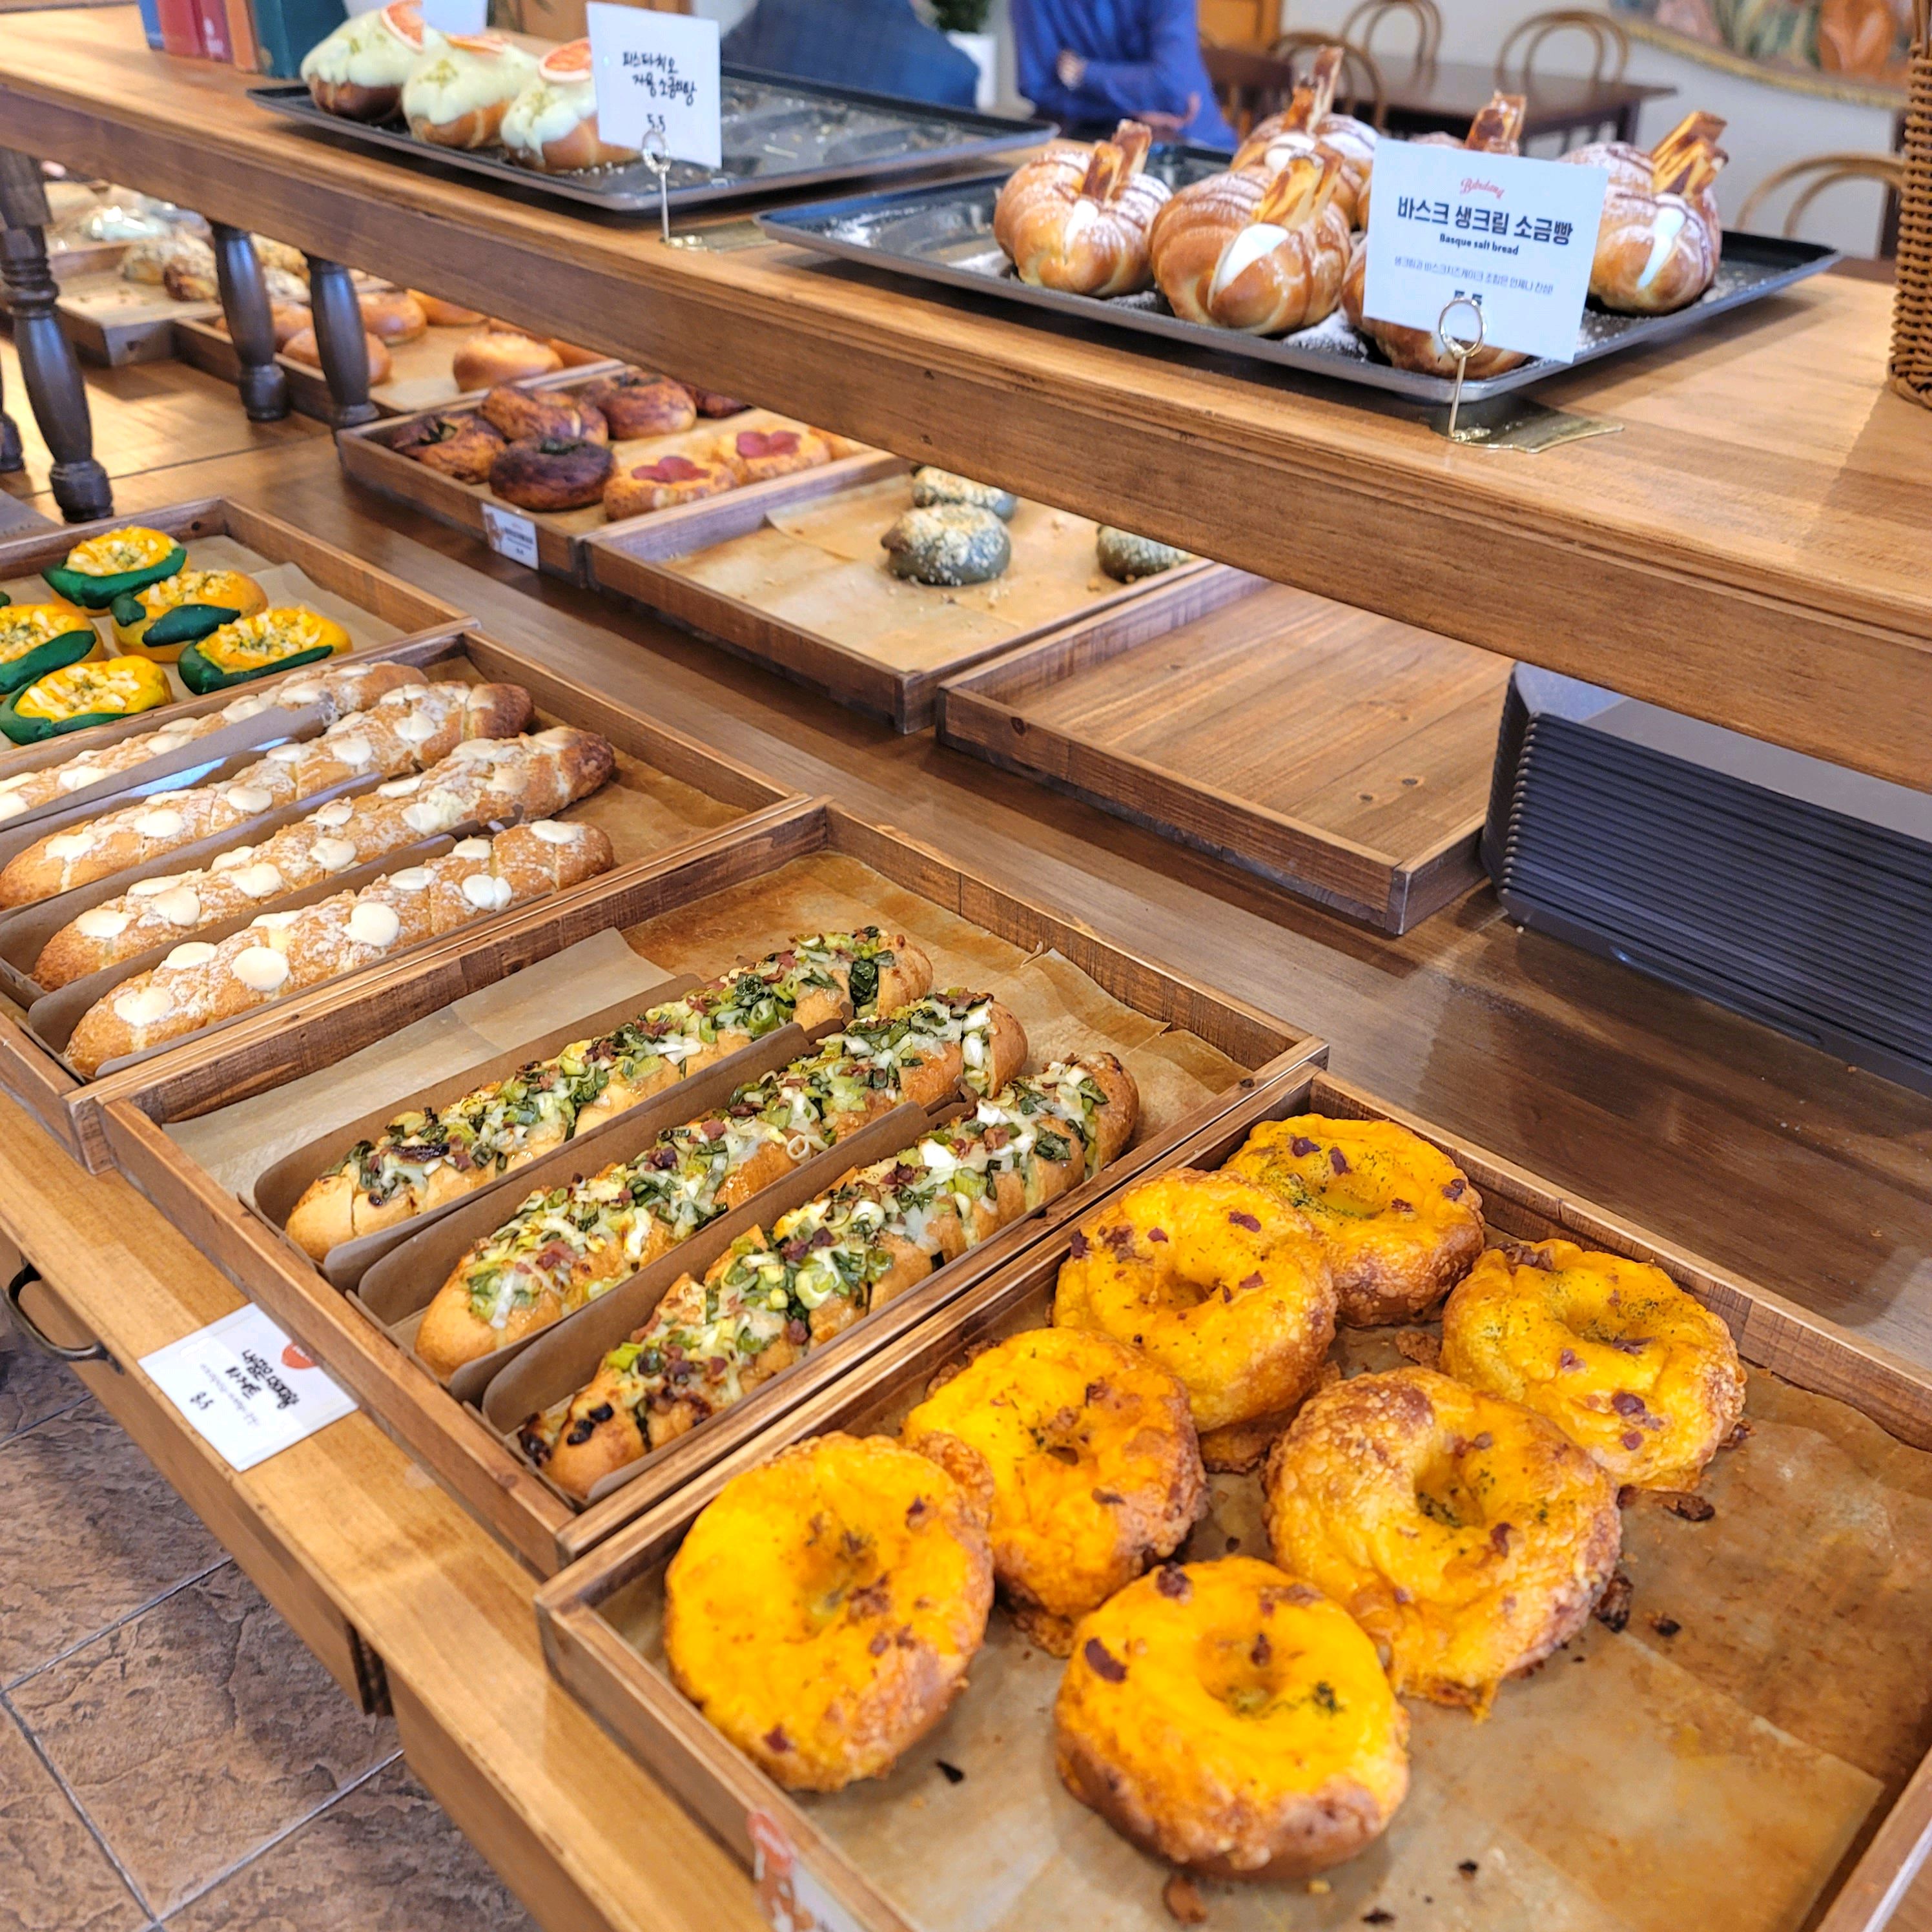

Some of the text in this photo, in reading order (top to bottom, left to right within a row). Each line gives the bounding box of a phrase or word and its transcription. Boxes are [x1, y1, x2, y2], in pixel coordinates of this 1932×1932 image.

[623, 51, 679, 74] 피스타치오
[1397, 196, 1574, 246] 바스크 생크림 소금빵
[1439, 233, 1519, 255] Basque salt bread
